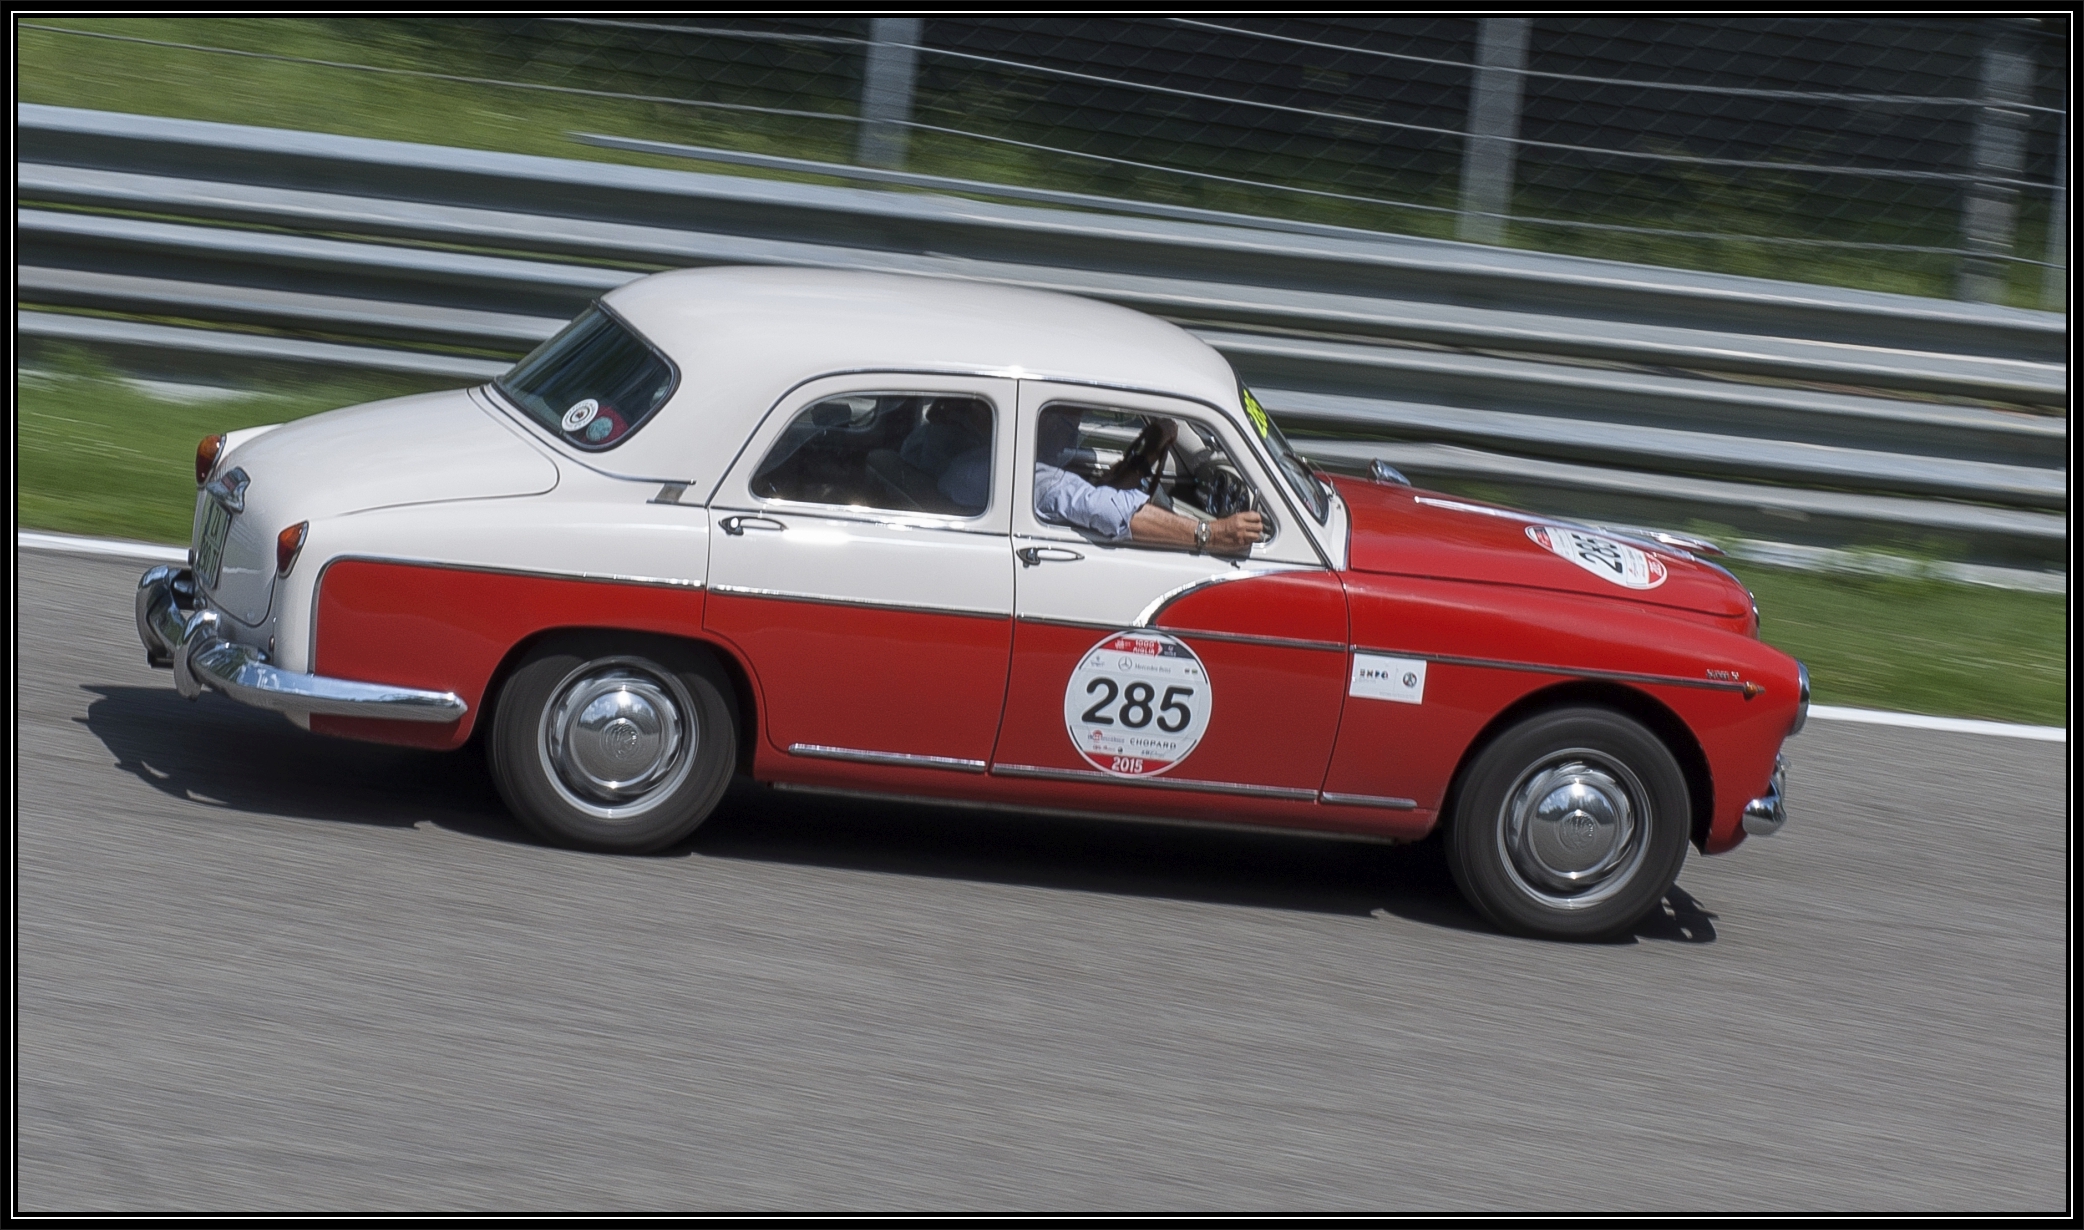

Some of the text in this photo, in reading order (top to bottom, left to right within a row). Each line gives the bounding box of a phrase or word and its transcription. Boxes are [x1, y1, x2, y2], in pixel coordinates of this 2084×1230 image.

[1135, 639, 1155, 648] 1000
[1081, 676, 1194, 733] 285
[1129, 737, 1177, 750] CHOPARD
[1111, 755, 1144, 774] 2015
